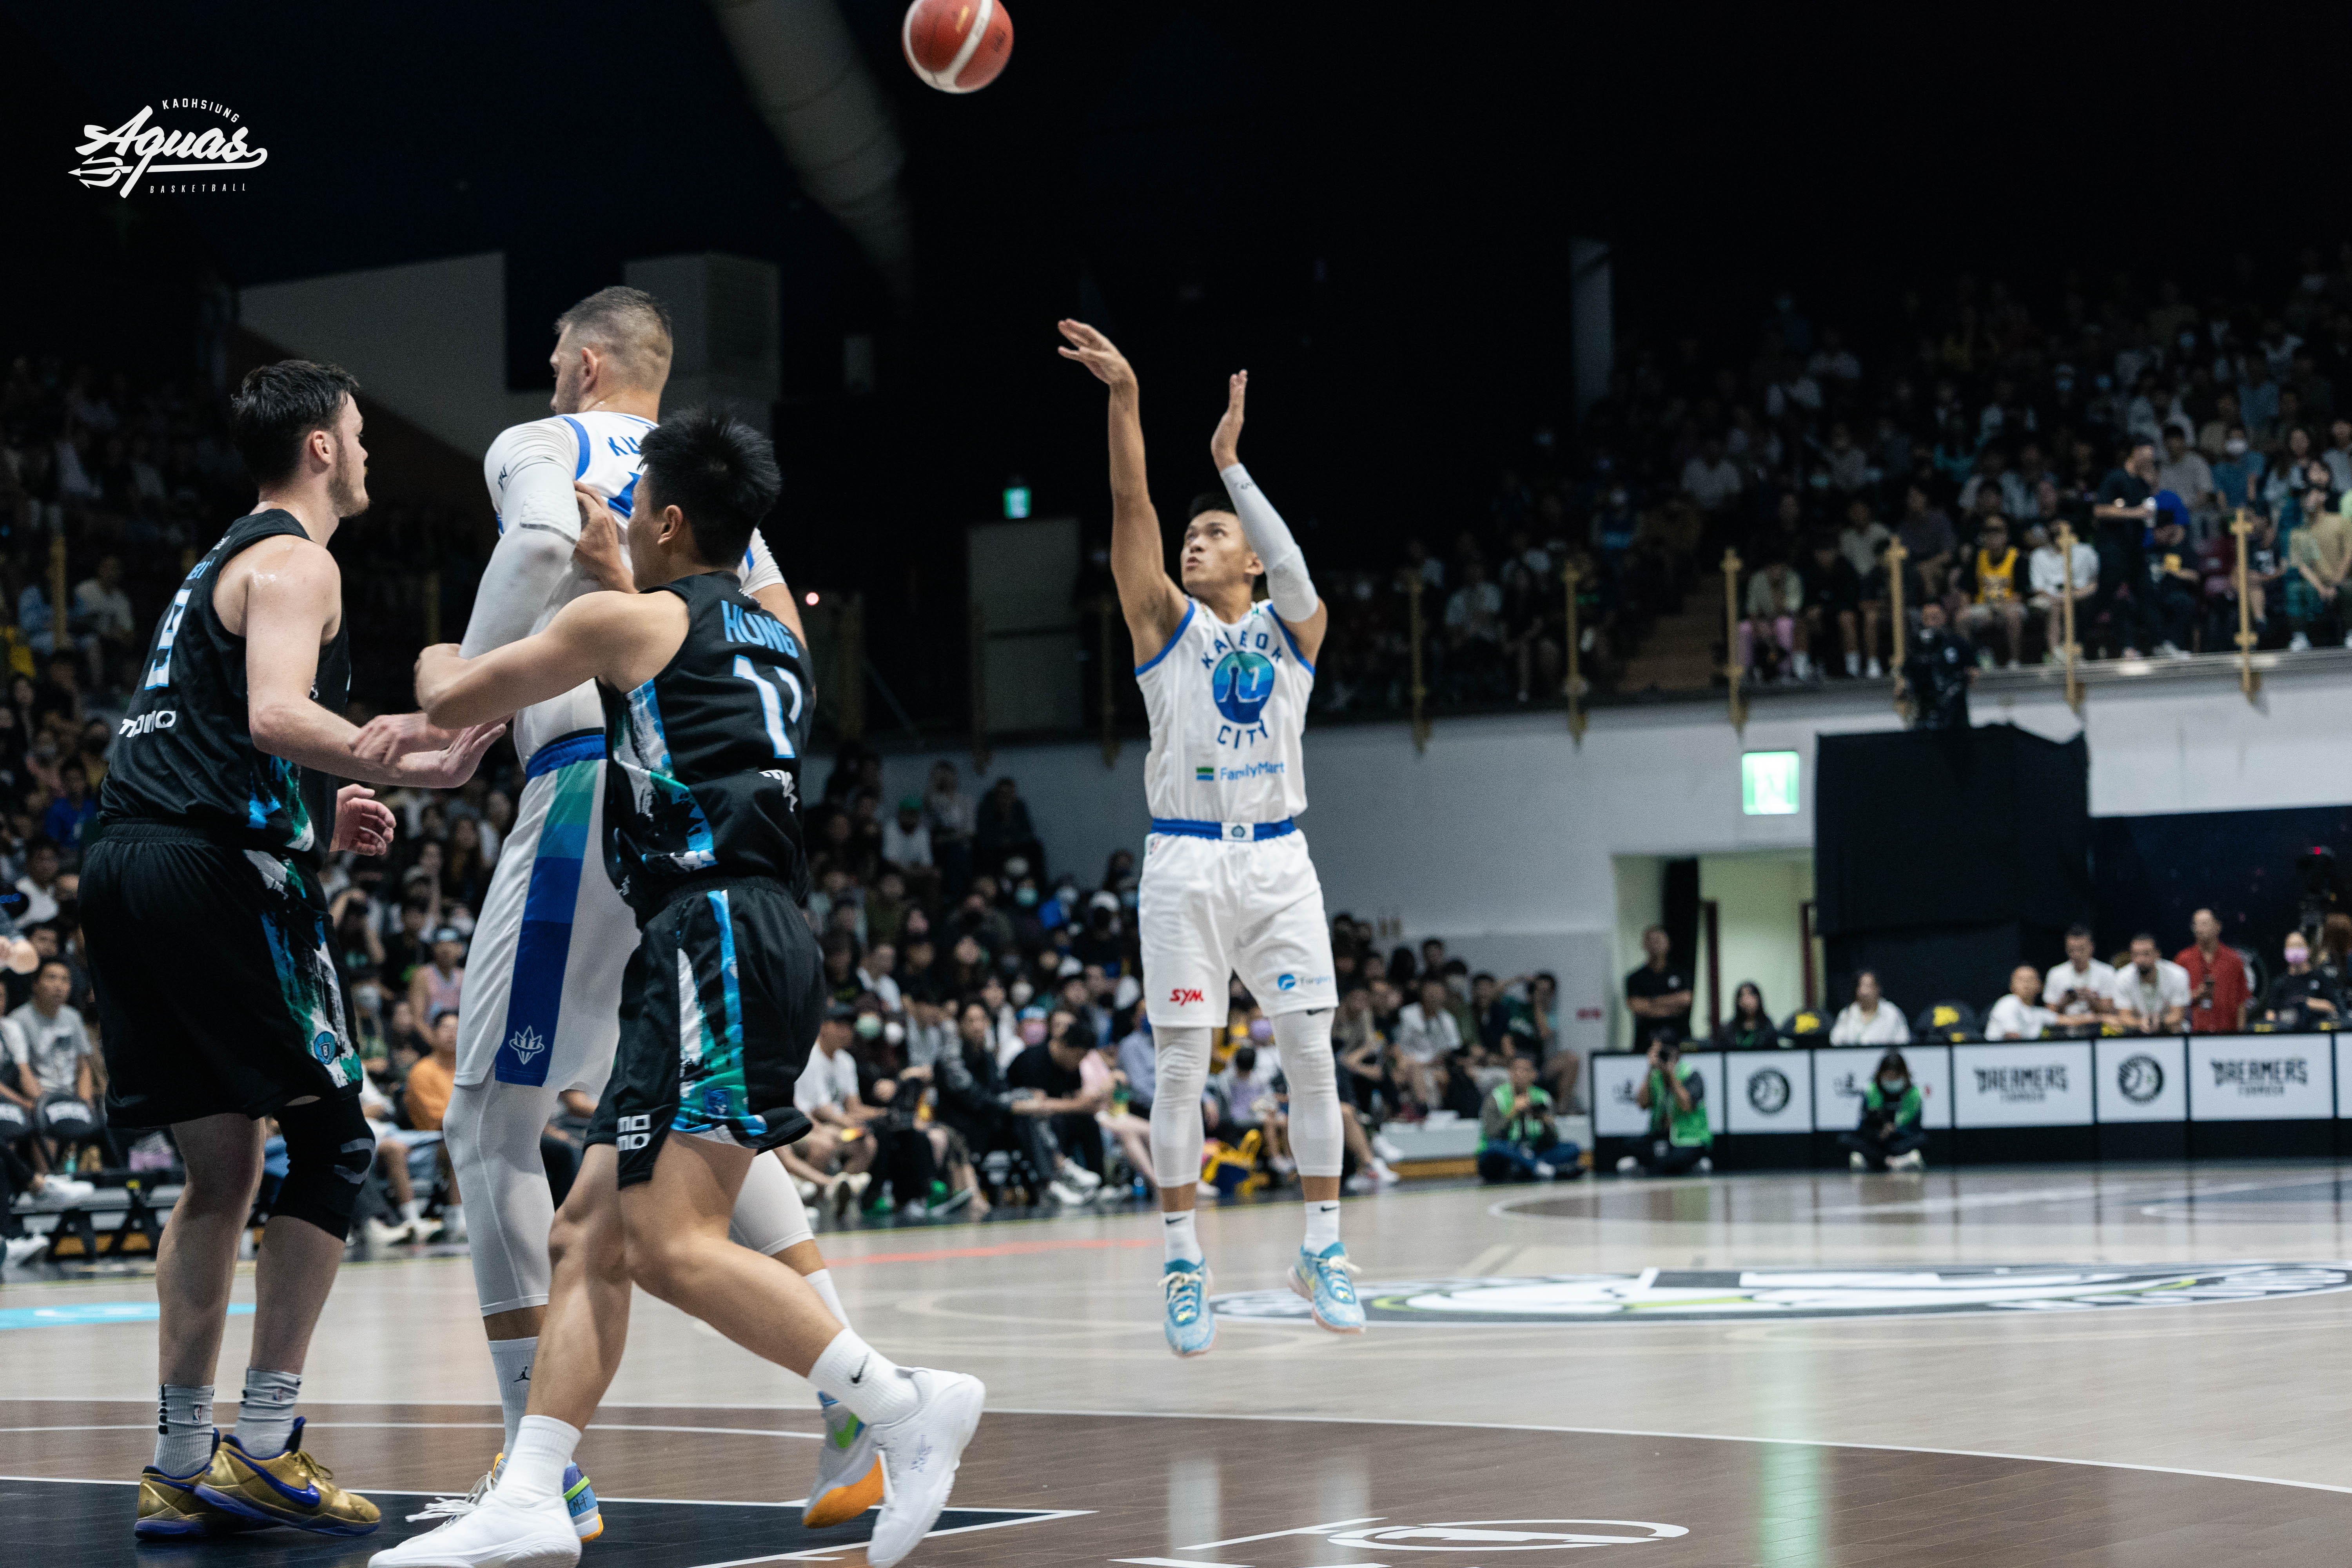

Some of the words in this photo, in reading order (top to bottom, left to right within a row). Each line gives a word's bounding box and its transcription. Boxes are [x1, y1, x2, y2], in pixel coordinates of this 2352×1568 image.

[721, 600, 799, 659] HUNG
[1217, 719, 1268, 749] CITY
[1169, 988, 1204, 1007] SYM
